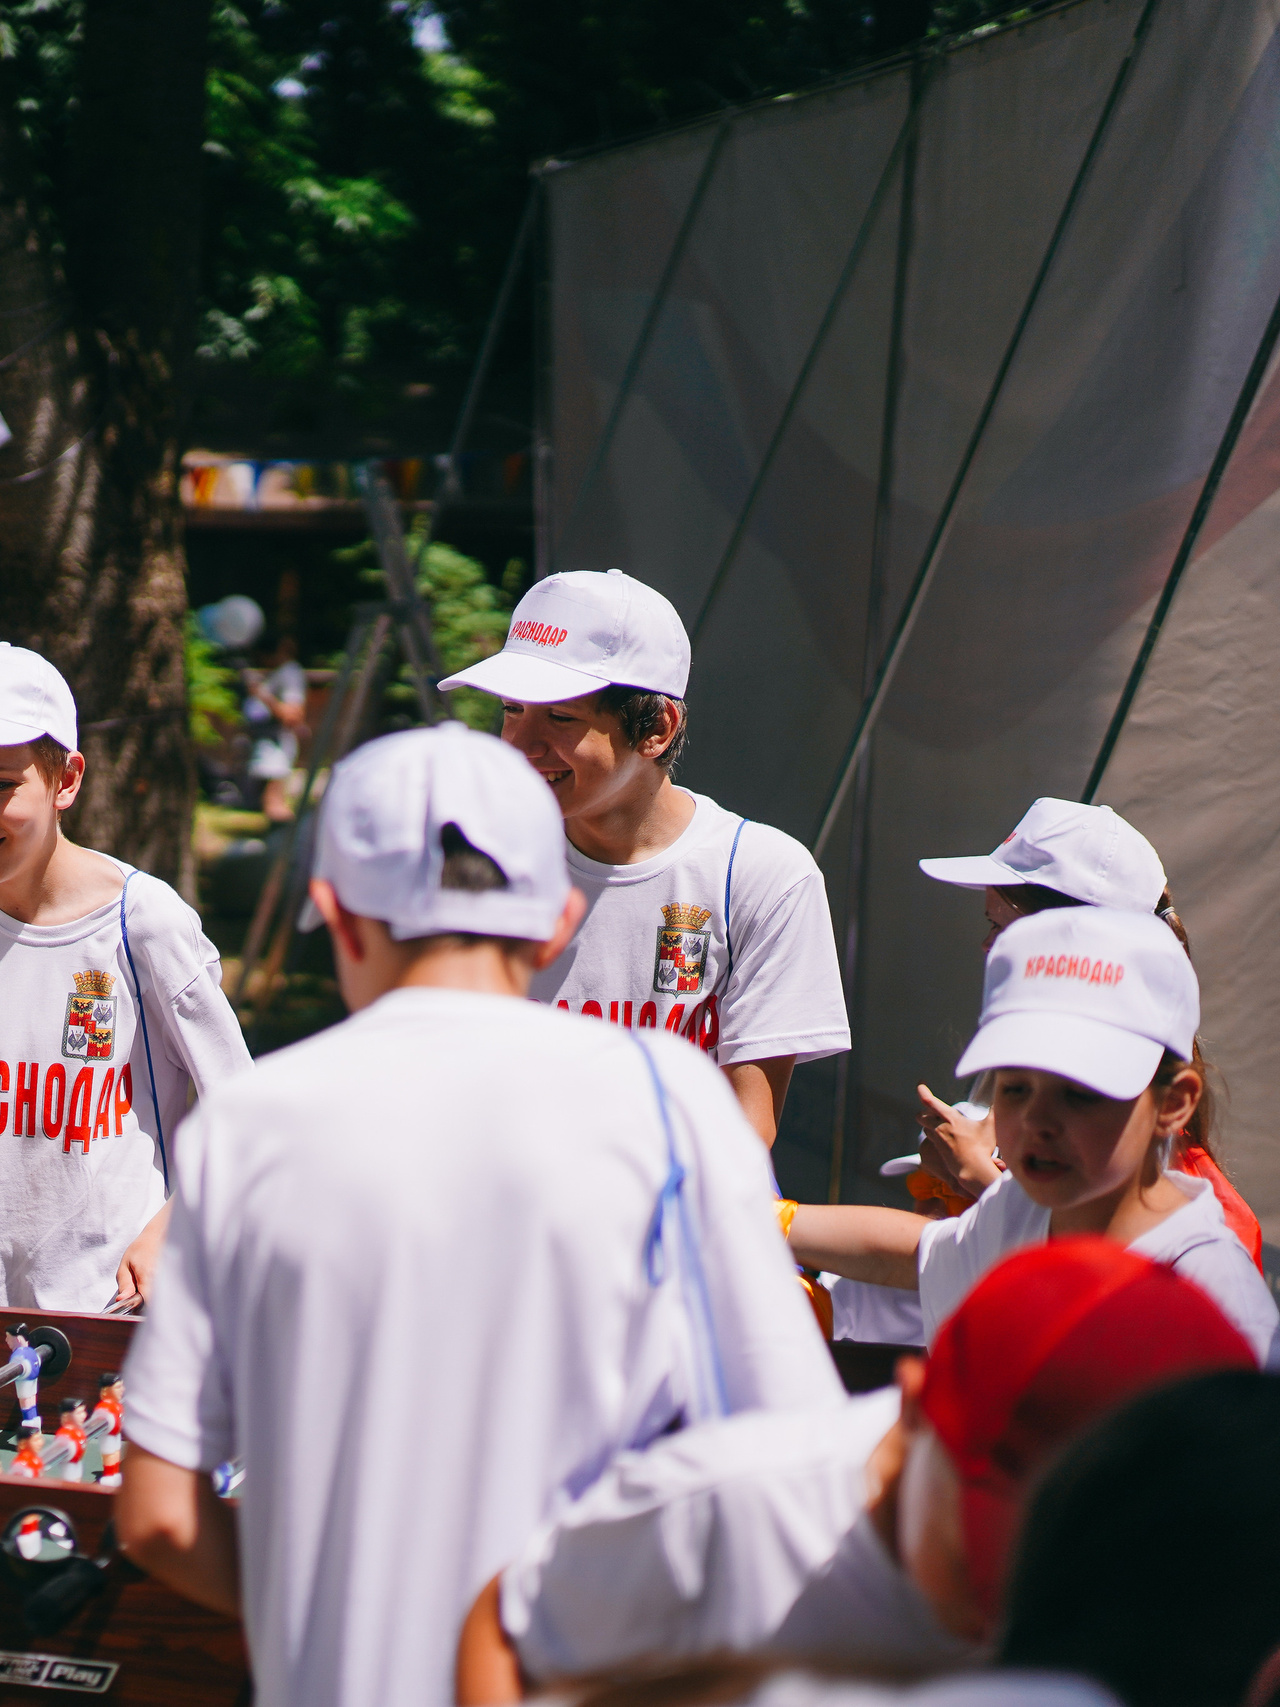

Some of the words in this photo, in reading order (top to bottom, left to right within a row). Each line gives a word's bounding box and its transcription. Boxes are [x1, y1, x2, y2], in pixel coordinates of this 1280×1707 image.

[508, 620, 568, 648] КРАСНОДАР
[1024, 953, 1125, 987] КРАСНОДАР
[50, 1663, 104, 1688] Play
